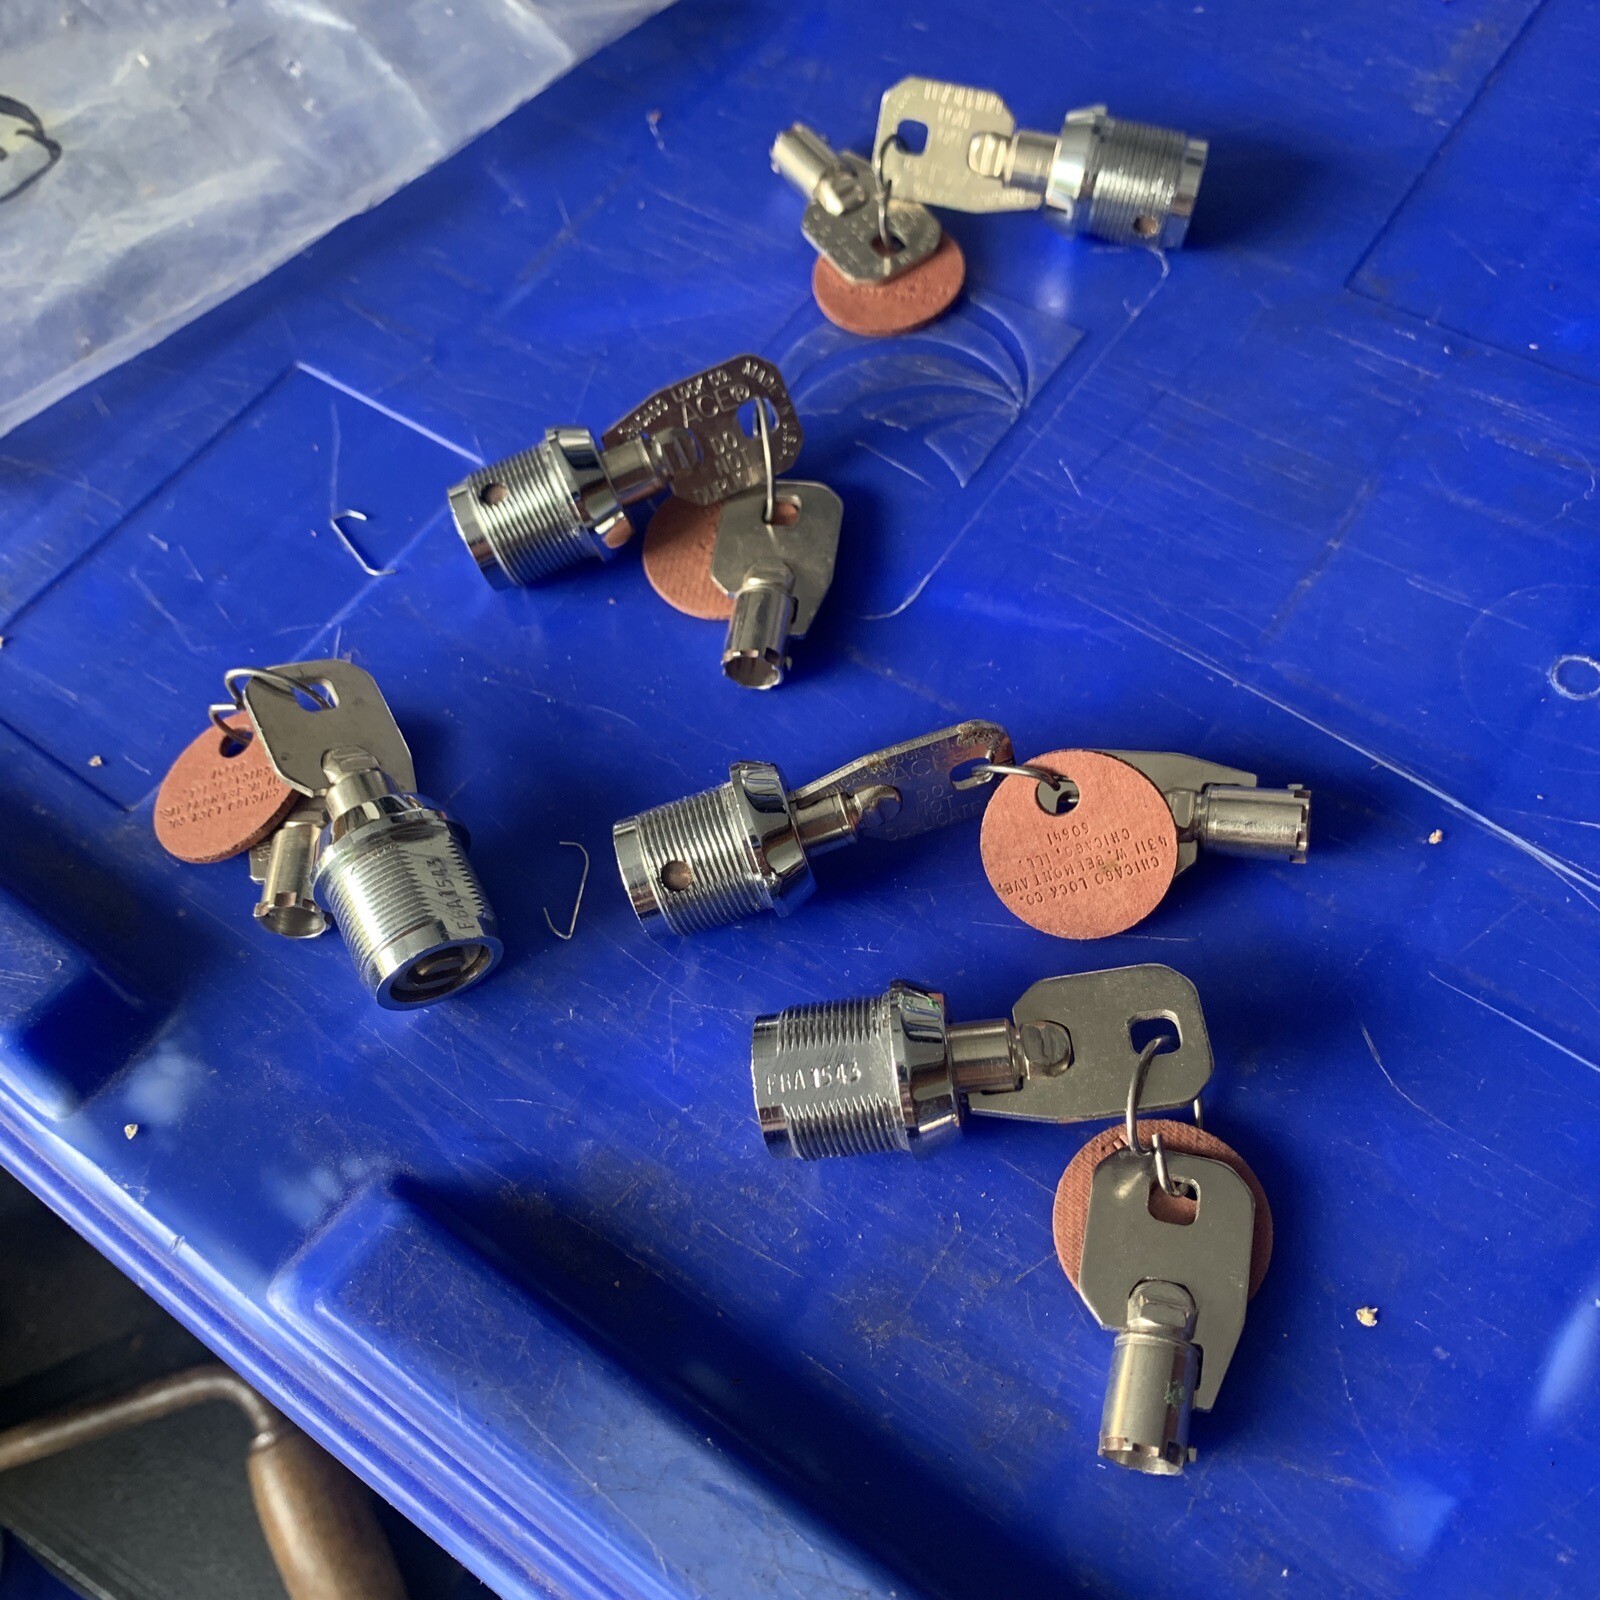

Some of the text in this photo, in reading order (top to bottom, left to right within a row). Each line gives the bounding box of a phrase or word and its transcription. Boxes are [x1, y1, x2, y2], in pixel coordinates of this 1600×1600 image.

[709, 431, 738, 455] DO
[916, 784, 944, 802] DO
[1047, 821, 1090, 846] 60641
[1108, 847, 1128, 862] W.
[1135, 835, 1168, 855] 4311
[1019, 856, 1053, 871] ILL.
[1035, 854, 1105, 886] BELMONT
[1019, 856, 1160, 906] CHICAGO LOCK CO.
